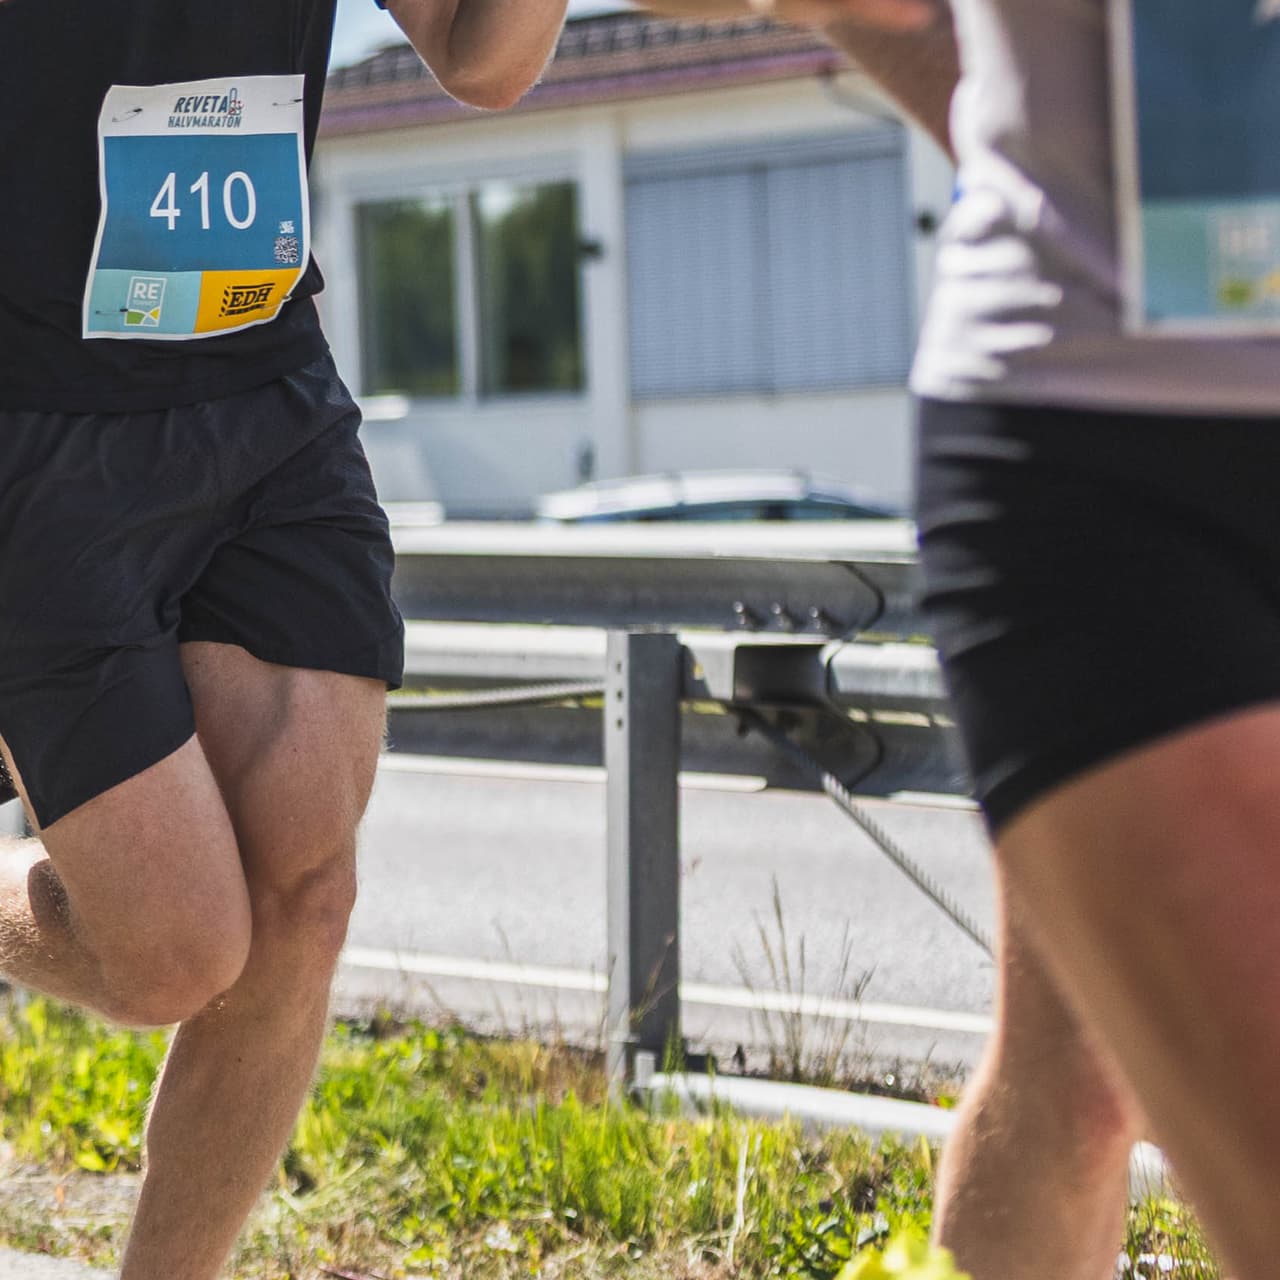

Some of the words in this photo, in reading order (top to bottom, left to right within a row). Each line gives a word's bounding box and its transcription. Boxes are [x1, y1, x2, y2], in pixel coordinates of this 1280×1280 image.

[174, 96, 229, 113] REVETA
[168, 115, 242, 128] HALVMARATON
[149, 171, 257, 230] 410
[133, 282, 160, 300] RE
[229, 287, 273, 308] EDH
